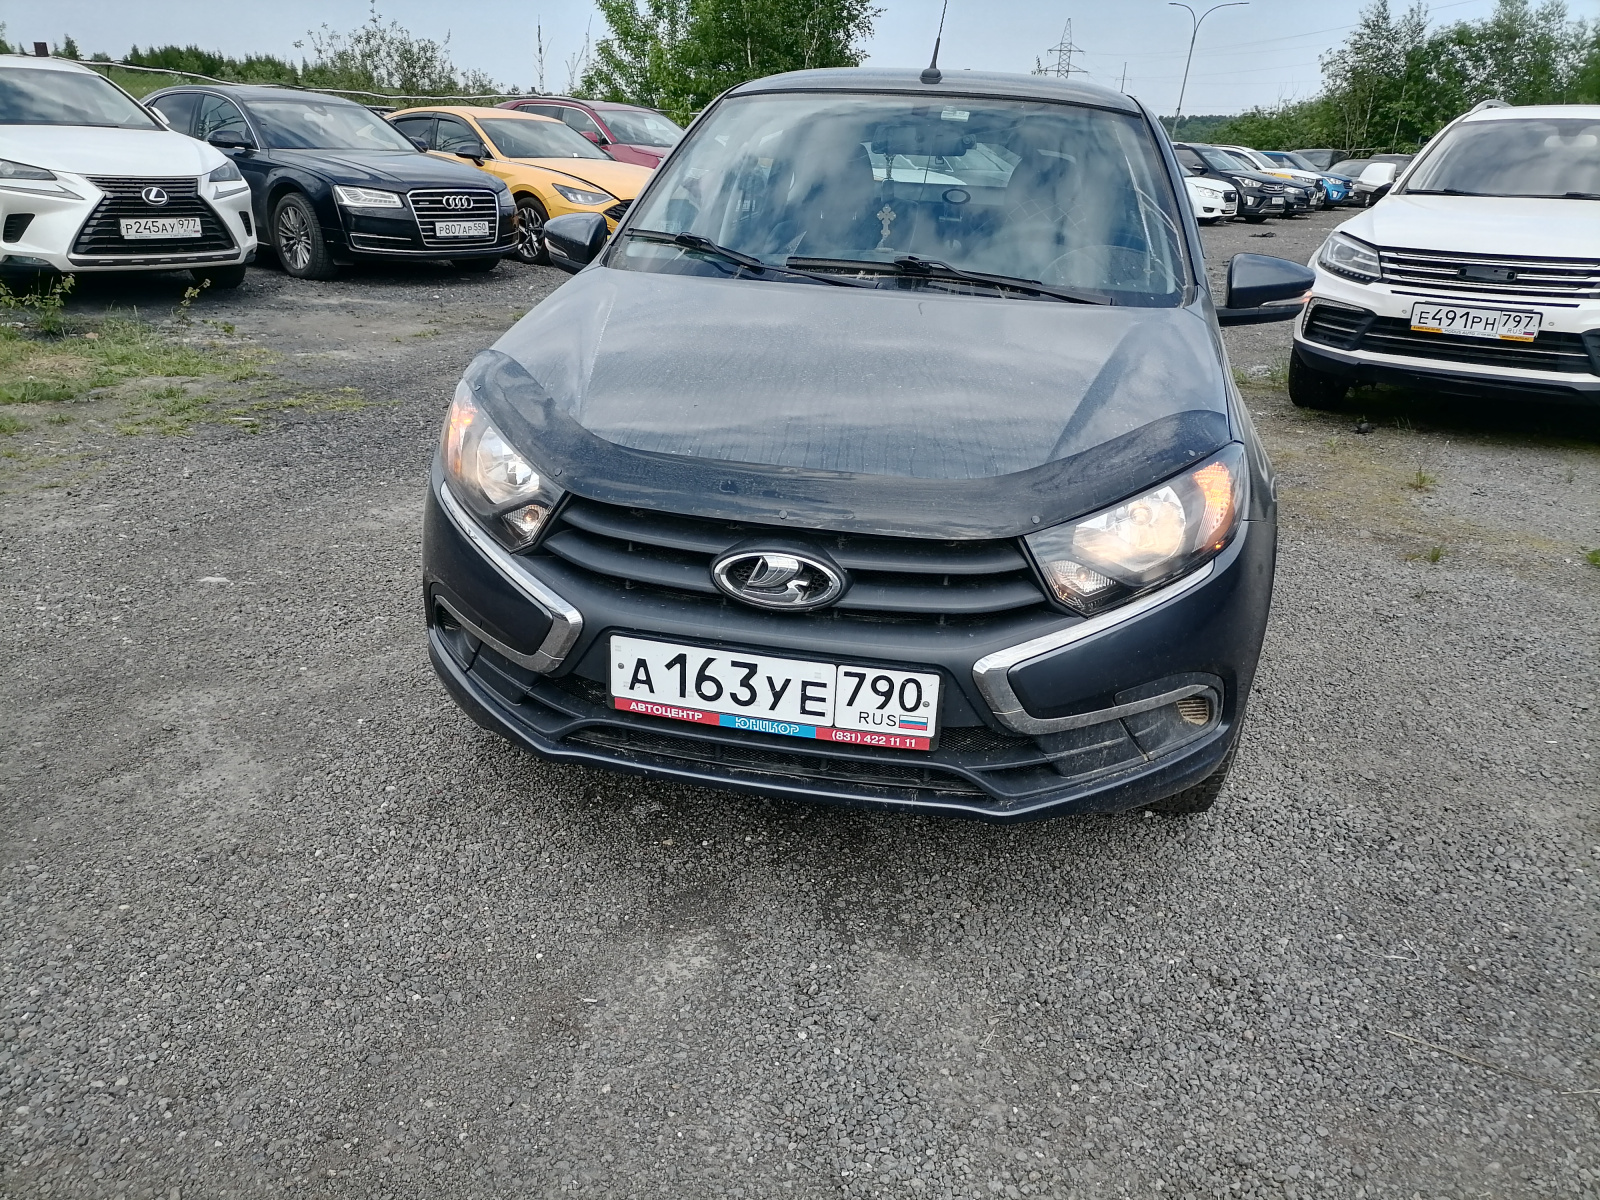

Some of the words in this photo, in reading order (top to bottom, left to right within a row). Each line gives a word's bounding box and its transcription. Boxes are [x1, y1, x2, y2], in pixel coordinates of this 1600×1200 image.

[125, 220, 176, 234] Р245АУ
[178, 219, 197, 229] 977
[1418, 308, 1497, 332] Е491РН
[1502, 313, 1535, 329] 797
[1507, 327, 1523, 335] RUS
[628, 652, 829, 717] А163УЕ
[843, 670, 923, 713] 790
[629, 701, 703, 721] АВТОЦЕНТР
[735, 717, 800, 736] ЮНИКОР
[858, 711, 897, 728] RUS
[832, 730, 861, 744] (831)
[863, 735, 886, 745] 422
[889, 737, 900, 747] 11
[905, 738, 916, 748] 11
